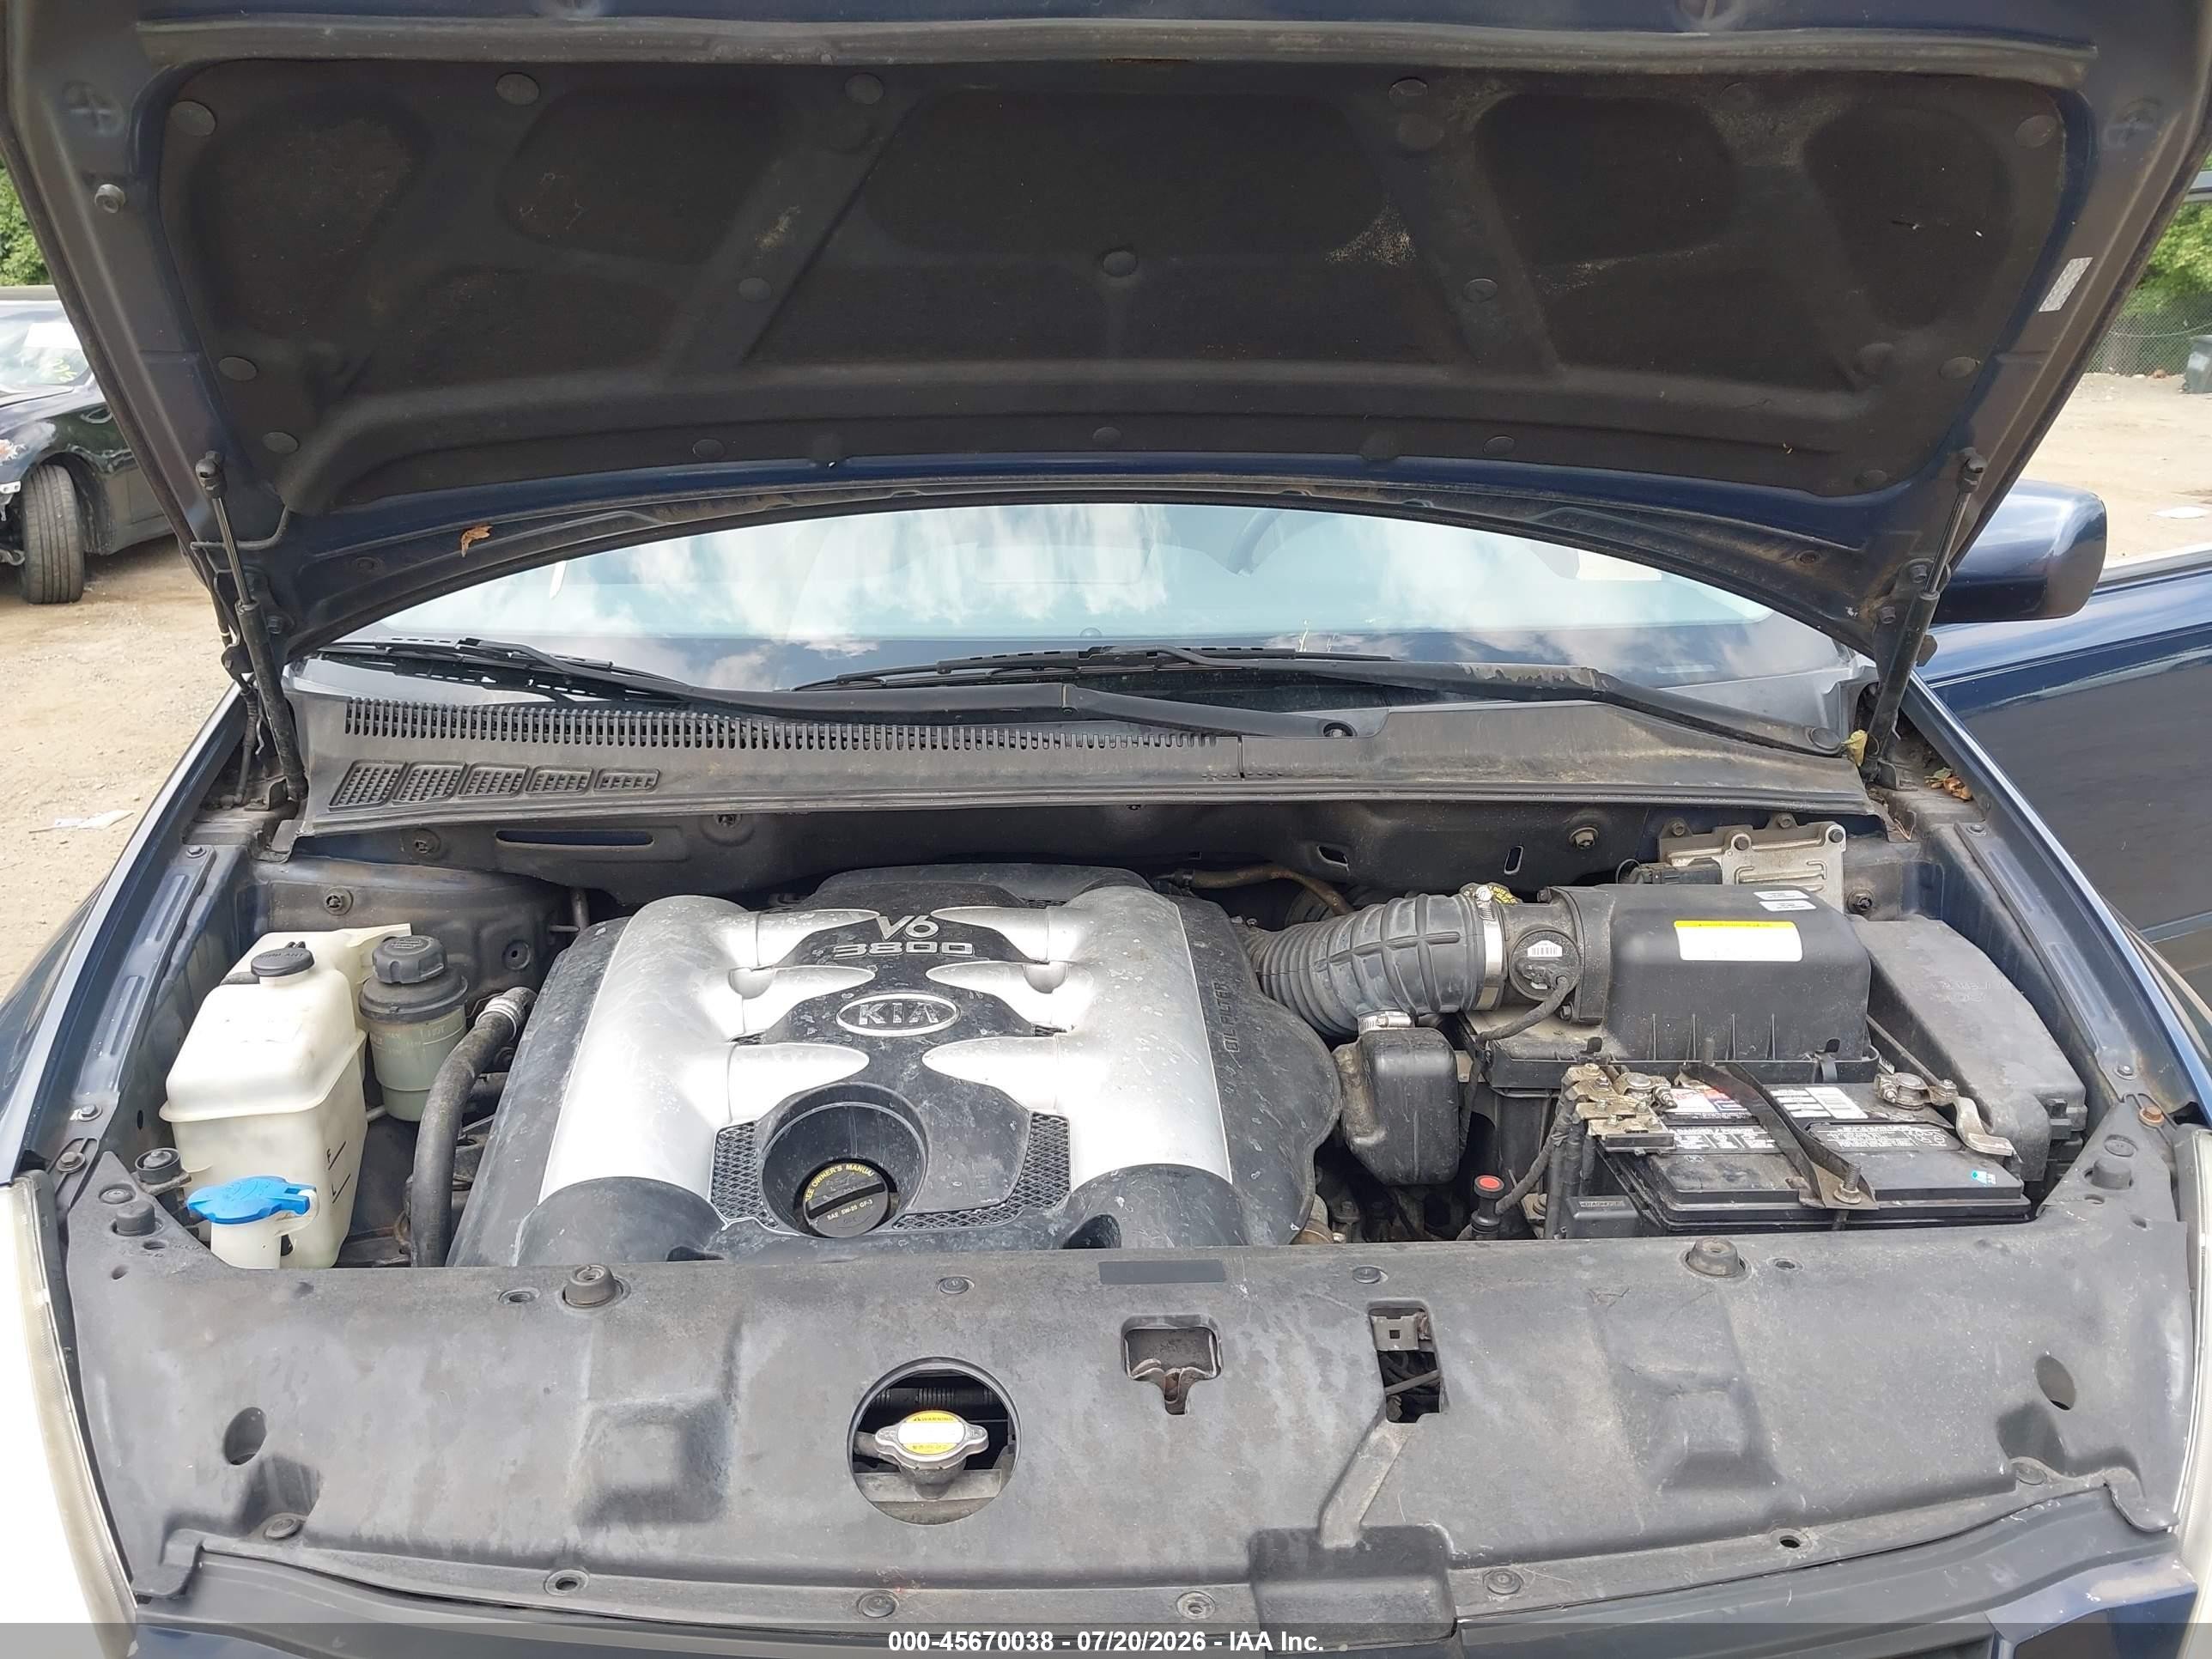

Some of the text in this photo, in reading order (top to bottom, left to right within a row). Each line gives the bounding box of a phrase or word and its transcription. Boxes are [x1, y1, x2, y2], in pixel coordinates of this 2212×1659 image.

[876, 915, 939, 940] V6
[833, 942, 974, 960] 3800
[859, 1002, 939, 1025] KIA
[1212, 981, 1240, 1053] OIL FILTER
[811, 1164, 842, 1187] OWNER'S
[827, 1212, 839, 1220] SAE
